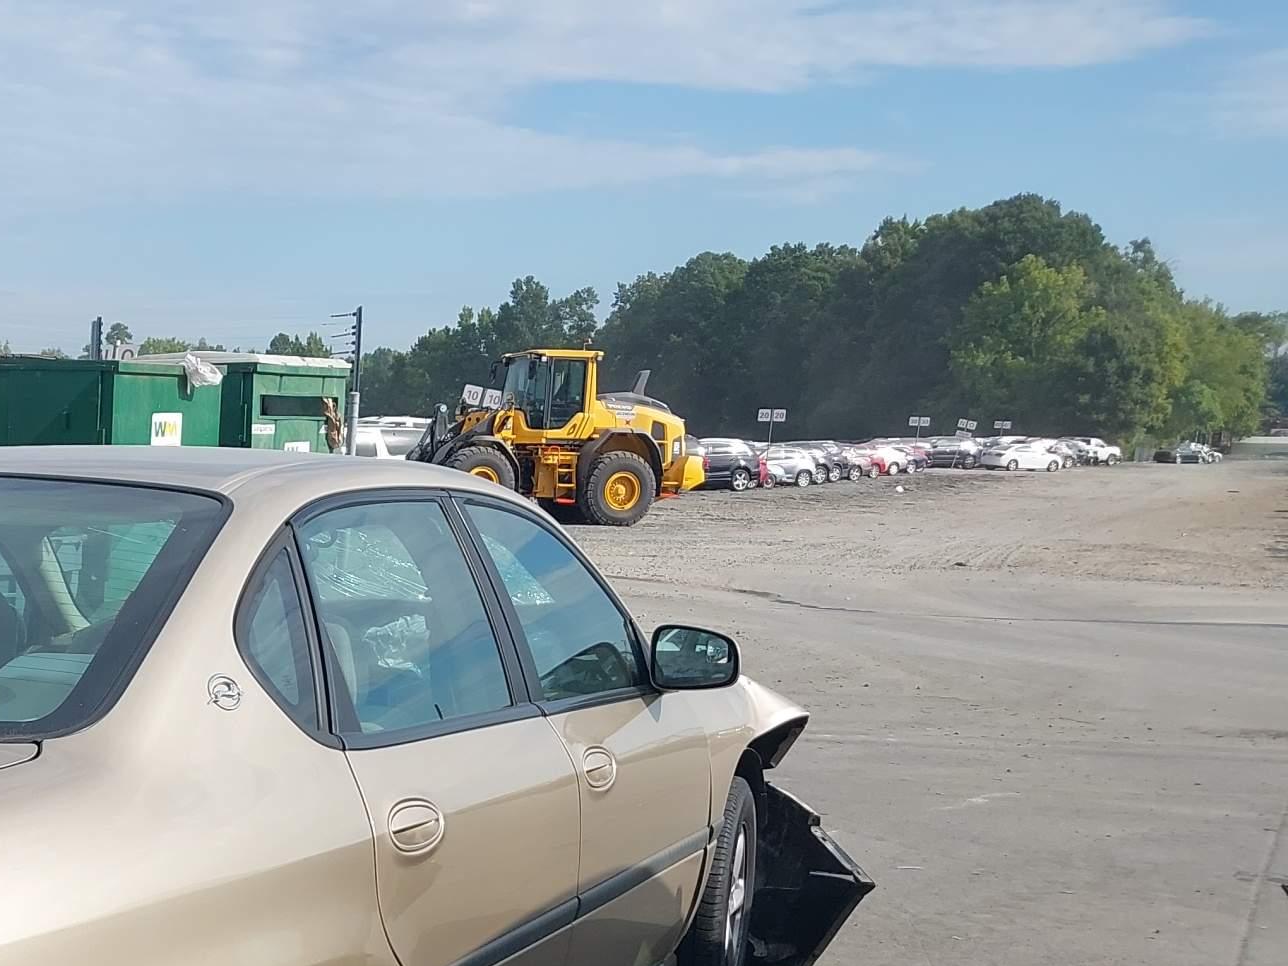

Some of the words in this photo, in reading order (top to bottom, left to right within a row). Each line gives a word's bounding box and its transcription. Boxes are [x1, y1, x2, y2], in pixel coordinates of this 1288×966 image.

[467, 390, 479, 401] 10
[488, 394, 501, 405] 10
[154, 421, 178, 437] WM
